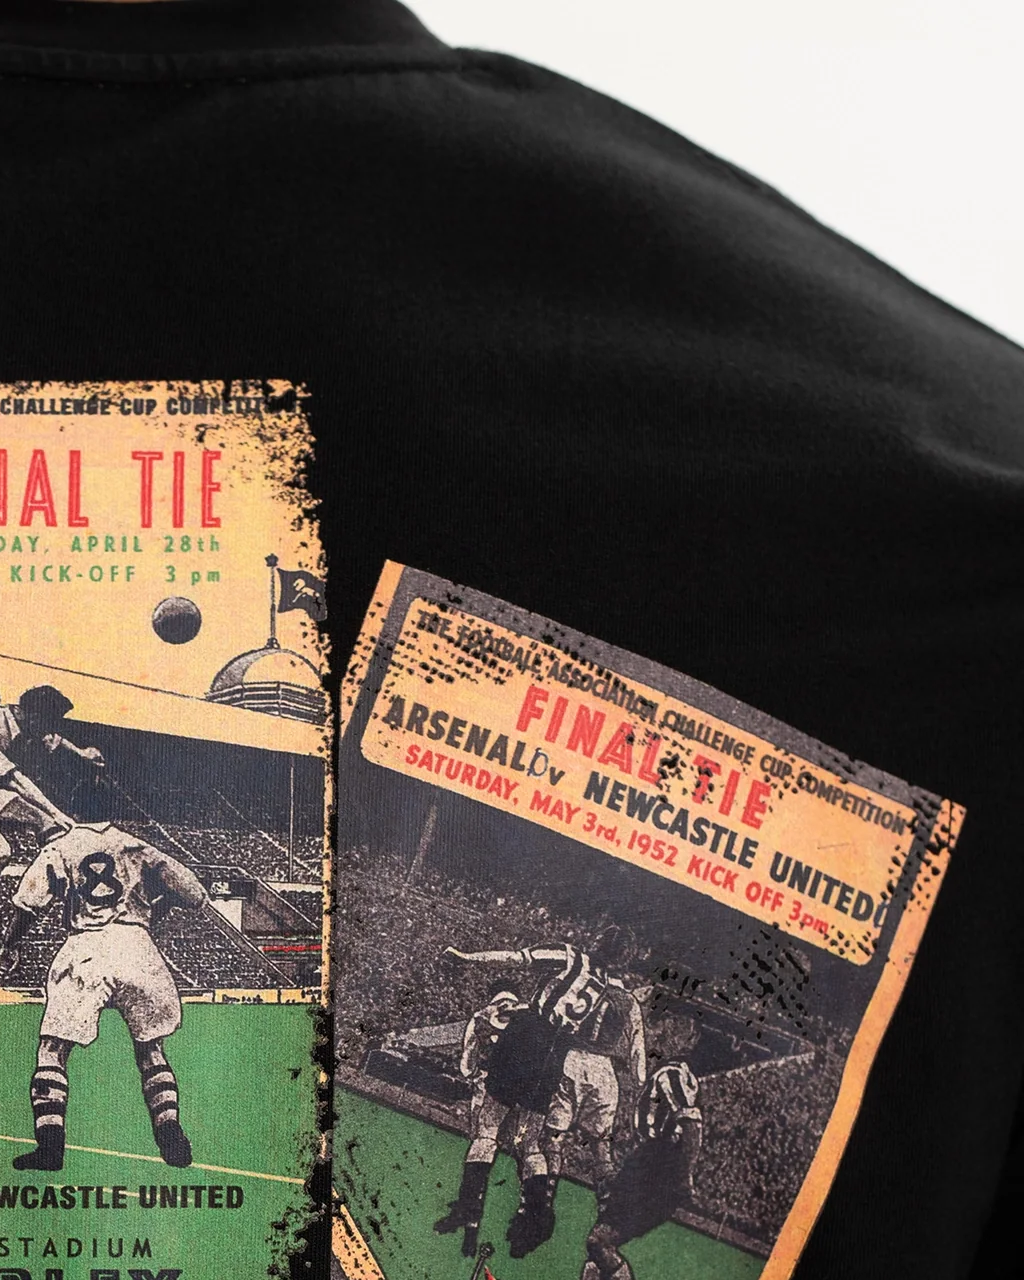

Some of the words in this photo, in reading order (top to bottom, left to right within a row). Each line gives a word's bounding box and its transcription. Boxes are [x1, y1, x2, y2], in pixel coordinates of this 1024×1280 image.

[0, 397, 111, 415] CHALLENGE
[119, 397, 157, 415] CUP
[166, 396, 292, 416] COMPETIT
[132, 450, 222, 528] TIE
[11, 564, 137, 583] KICK-OFF
[165, 565, 176, 583] 3
[191, 568, 221, 587] pm
[71, 534, 144, 554] APRIL
[164, 534, 221, 554] 28th
[515, 685, 664, 785] FINAL
[691, 754, 772, 830] TIE
[663, 710, 757, 765] CHALLENGE
[759, 754, 793, 780] CUP
[797, 771, 907, 836] COMPETITION
[382, 697, 526, 772] ARSENAL
[583, 771, 759, 869] NEWCASTLE
[769, 851, 875, 922] UNITED
[405, 744, 520, 806] SATURDAY,
[529, 790, 581, 824] MAY
[582, 812, 621, 848] 3rd,
[627, 830, 679, 867] 1952
[686, 854, 739, 892] KICK
[745, 882, 785, 912] OFF
[79, 852, 123, 906] 8
[140, 1185, 245, 1210] UNITED
